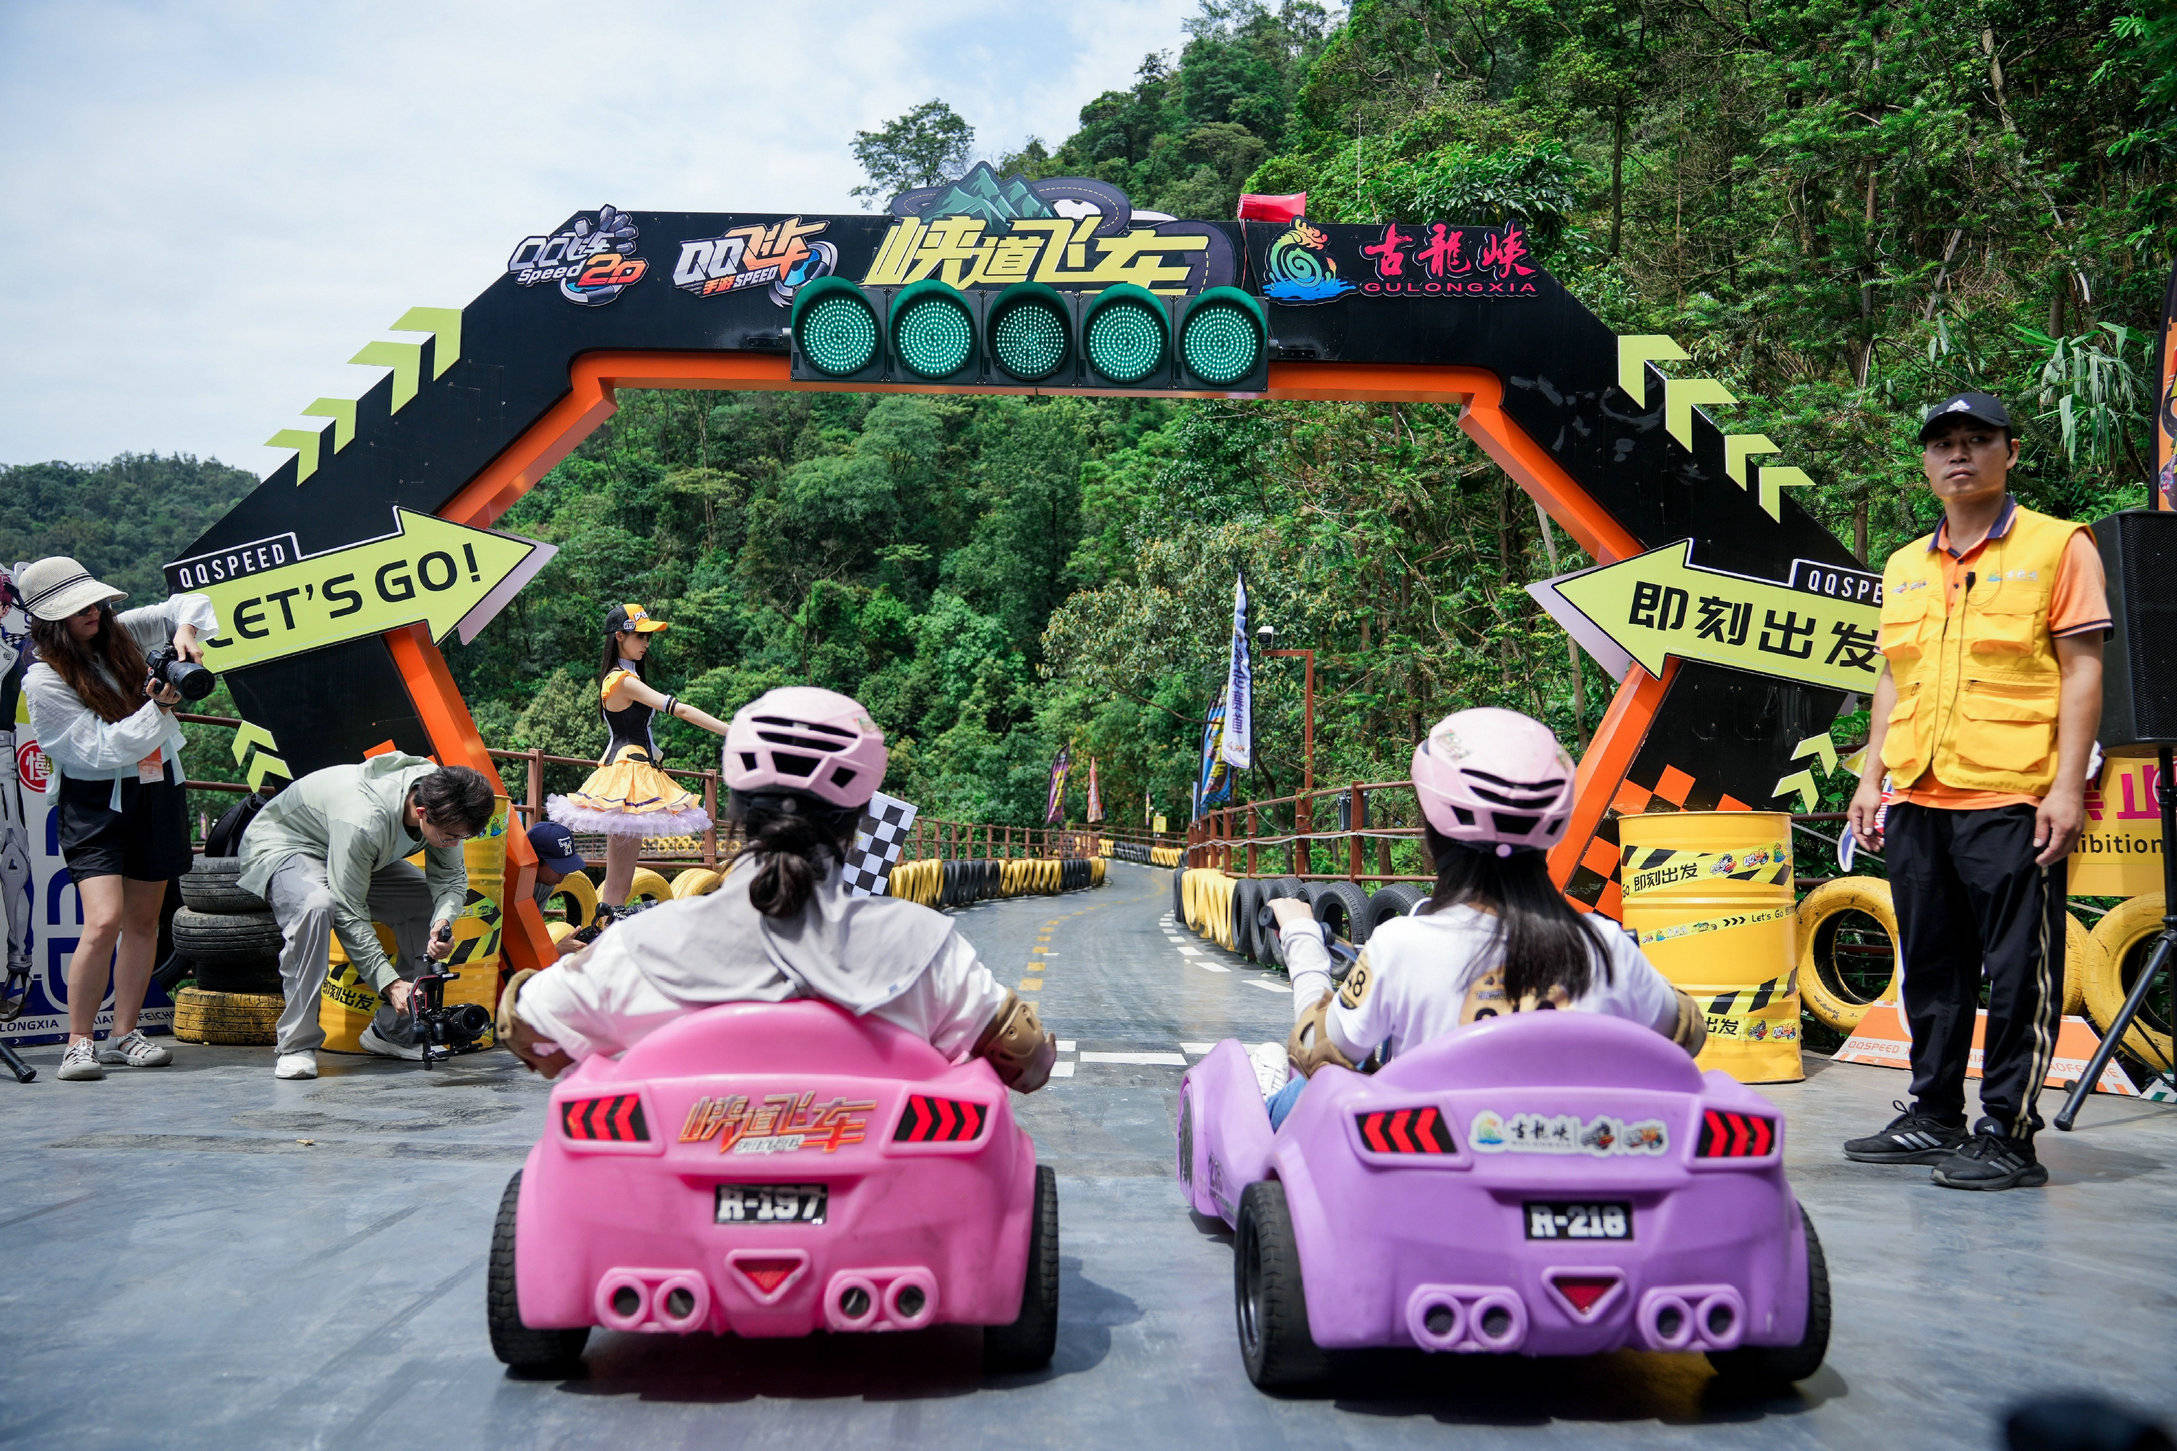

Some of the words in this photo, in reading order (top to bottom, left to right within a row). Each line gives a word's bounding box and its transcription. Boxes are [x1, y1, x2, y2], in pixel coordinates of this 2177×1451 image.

[517, 260, 589, 285] Speed
[733, 265, 780, 288] SPEED
[1364, 282, 1536, 293] GULONGXIA
[179, 543, 286, 588] QQSPEED
[375, 542, 481, 603] GO!
[1807, 569, 1883, 604] QQSPE
[1628, 580, 1877, 674] 即刻出发
[1633, 862, 1699, 892] 即刻出发
[1751, 912, 1772, 923] Let's
[1774, 908, 1784, 919] Go
[0, 1018, 59, 1032] LONGXIA
